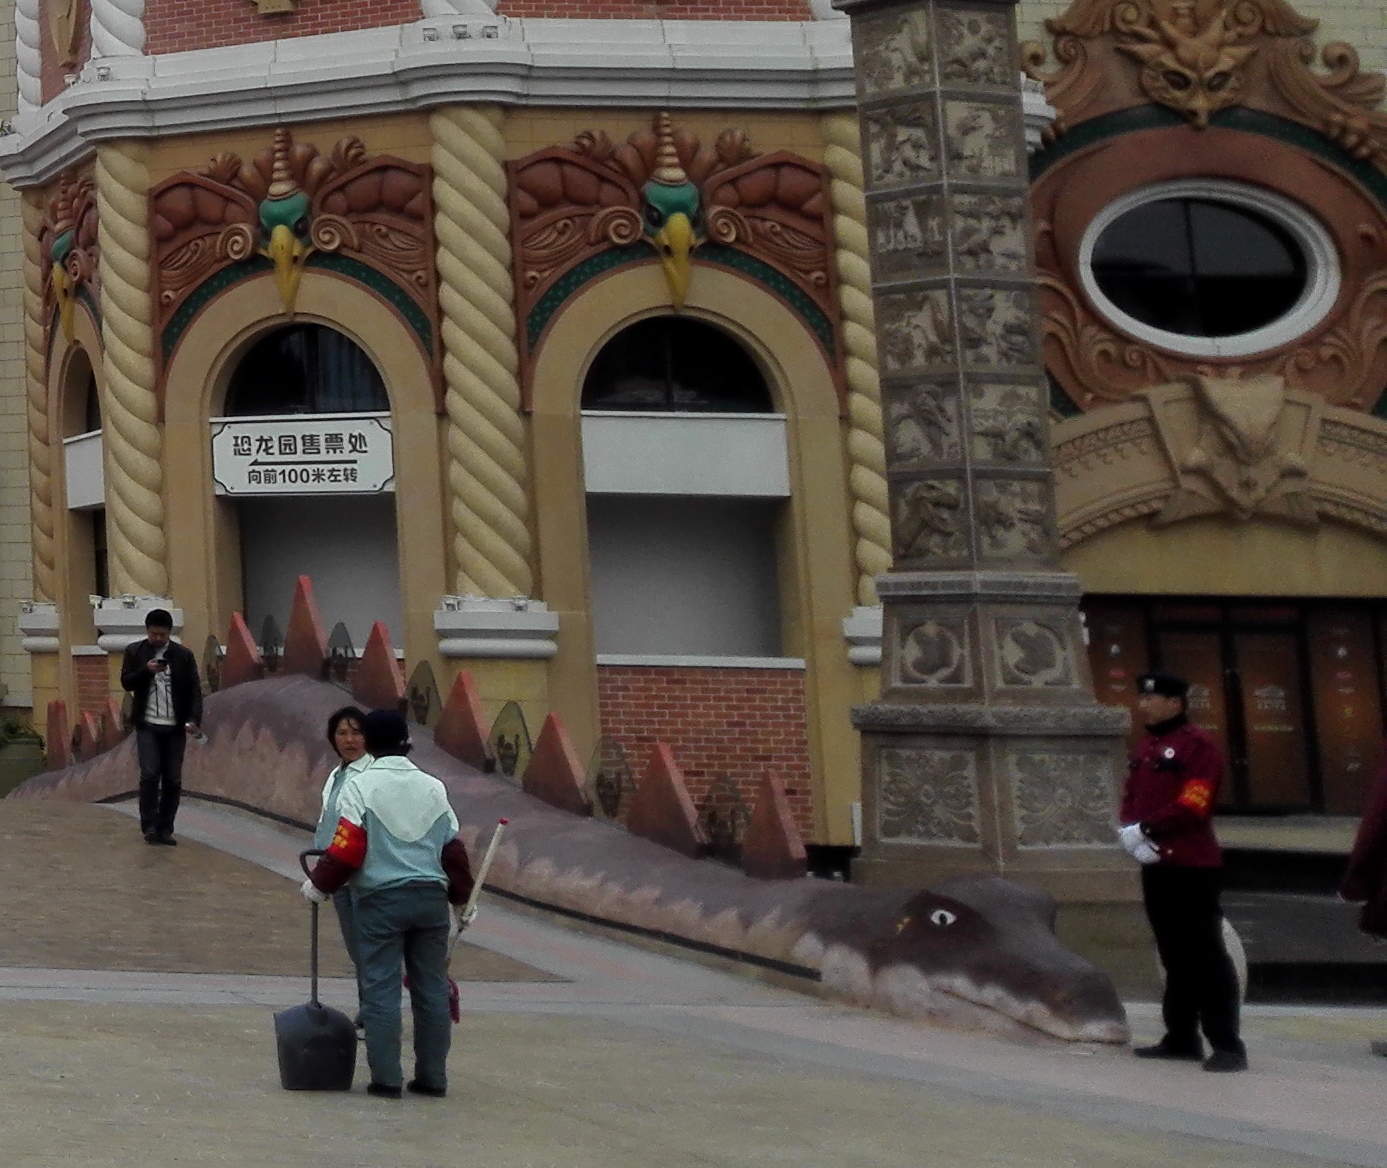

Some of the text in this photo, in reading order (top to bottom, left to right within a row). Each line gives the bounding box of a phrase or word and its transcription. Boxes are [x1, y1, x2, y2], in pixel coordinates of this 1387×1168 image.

[233, 432, 368, 456] 恐龙园售票处
[248, 467, 358, 485] 向前100米左转
